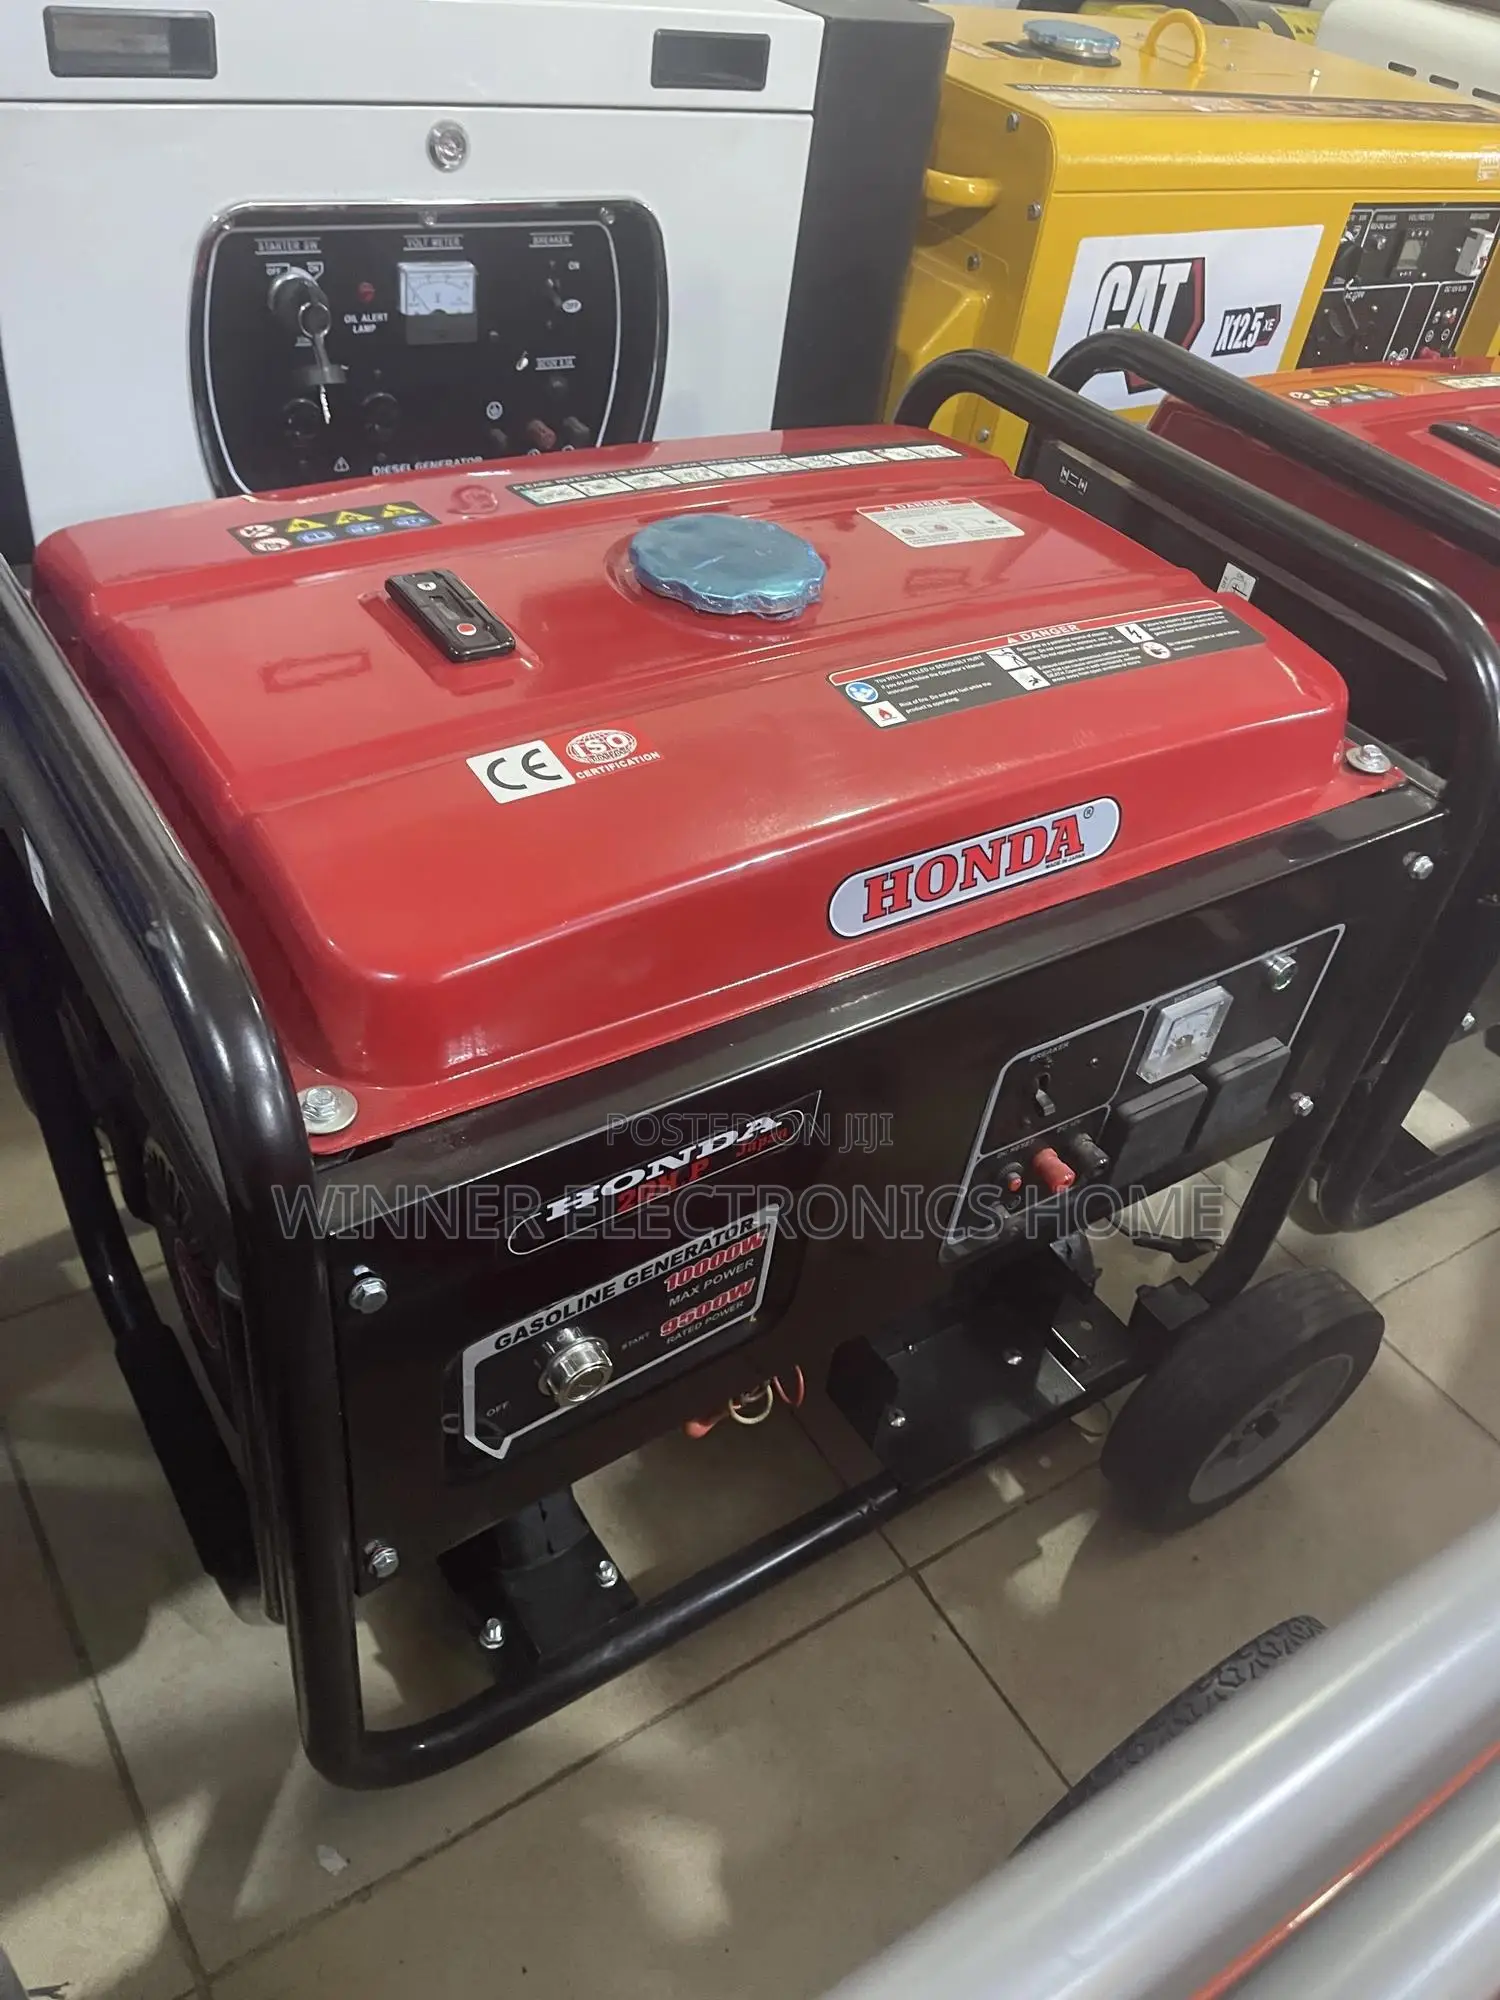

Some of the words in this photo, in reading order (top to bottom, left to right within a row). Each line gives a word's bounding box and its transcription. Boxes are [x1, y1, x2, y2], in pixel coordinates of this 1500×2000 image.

[407, 237, 429, 248] VOLT
[432, 236, 461, 248] METER
[532, 234, 571, 245] BREAKER
[568, 261, 580, 270] ON
[1087, 263, 1193, 337] CAT
[344, 314, 358, 324] OIL
[361, 312, 389, 322] ALERT
[352, 324, 377, 334] LAMP
[1262, 318, 1276, 332] XE
[372, 463, 412, 476] DIESEL
[414, 456, 484, 471] GENERATOR
[1020, 624, 1081, 640] DANGER
[572, 733, 629, 758] ISO
[486, 748, 563, 790] CE
[575, 751, 661, 779] CERTIFICATION
[862, 815, 1085, 923] HONDA
[546, 1116, 783, 1222] HONDA
[664, 1228, 768, 1292] 10000W
[494, 1282, 616, 1350] GASOLINE
[623, 1217, 754, 1289] GENERATOR
[669, 1283, 700, 1307] MAX
[703, 1257, 755, 1290] POWER
[660, 1277, 757, 1337] 9500W
[666, 1321, 703, 1344] RATED
[705, 1301, 744, 1325] POWER
[621, 1332, 651, 1350] START
[486, 1401, 511, 1417] OFF
